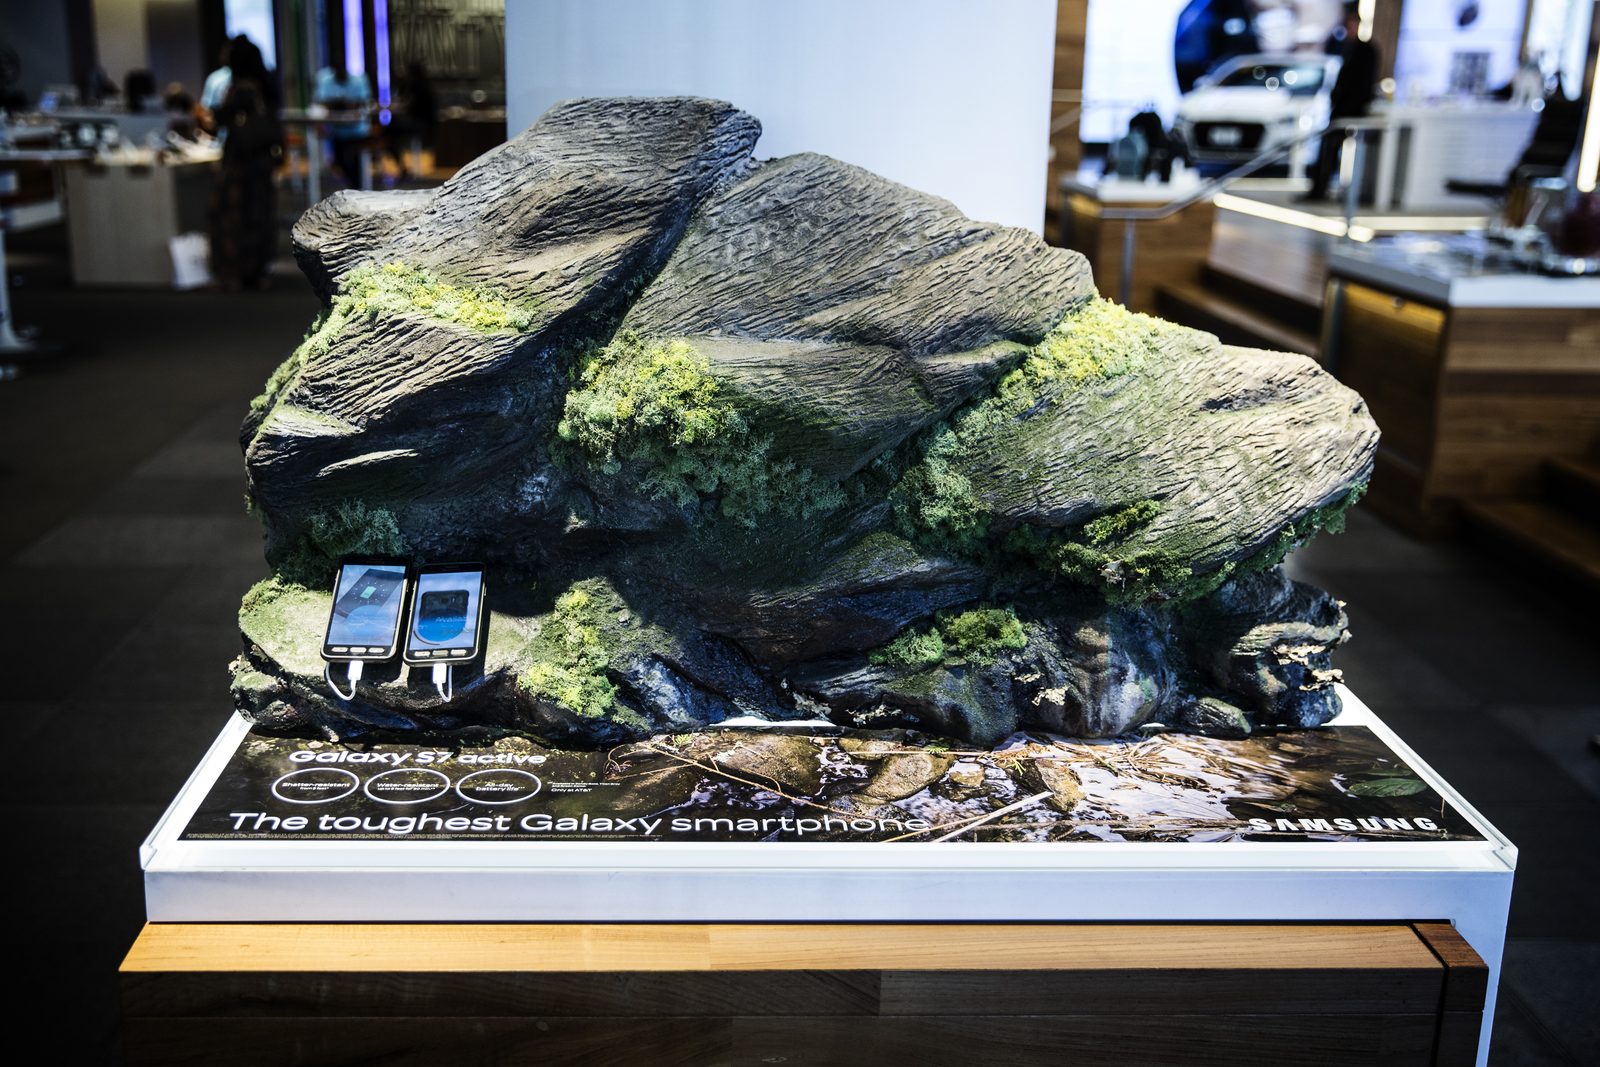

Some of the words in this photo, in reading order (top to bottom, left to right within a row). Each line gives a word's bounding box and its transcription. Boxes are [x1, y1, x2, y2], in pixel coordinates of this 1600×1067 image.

[288, 750, 413, 766] Galaxy
[414, 751, 454, 764] S7
[458, 753, 547, 764] active
[229, 812, 309, 830] The
[319, 813, 512, 834] toughest
[521, 813, 662, 835] Galaxy
[671, 814, 929, 835] smartphone
[1248, 817, 1438, 831] SAMSUNG
